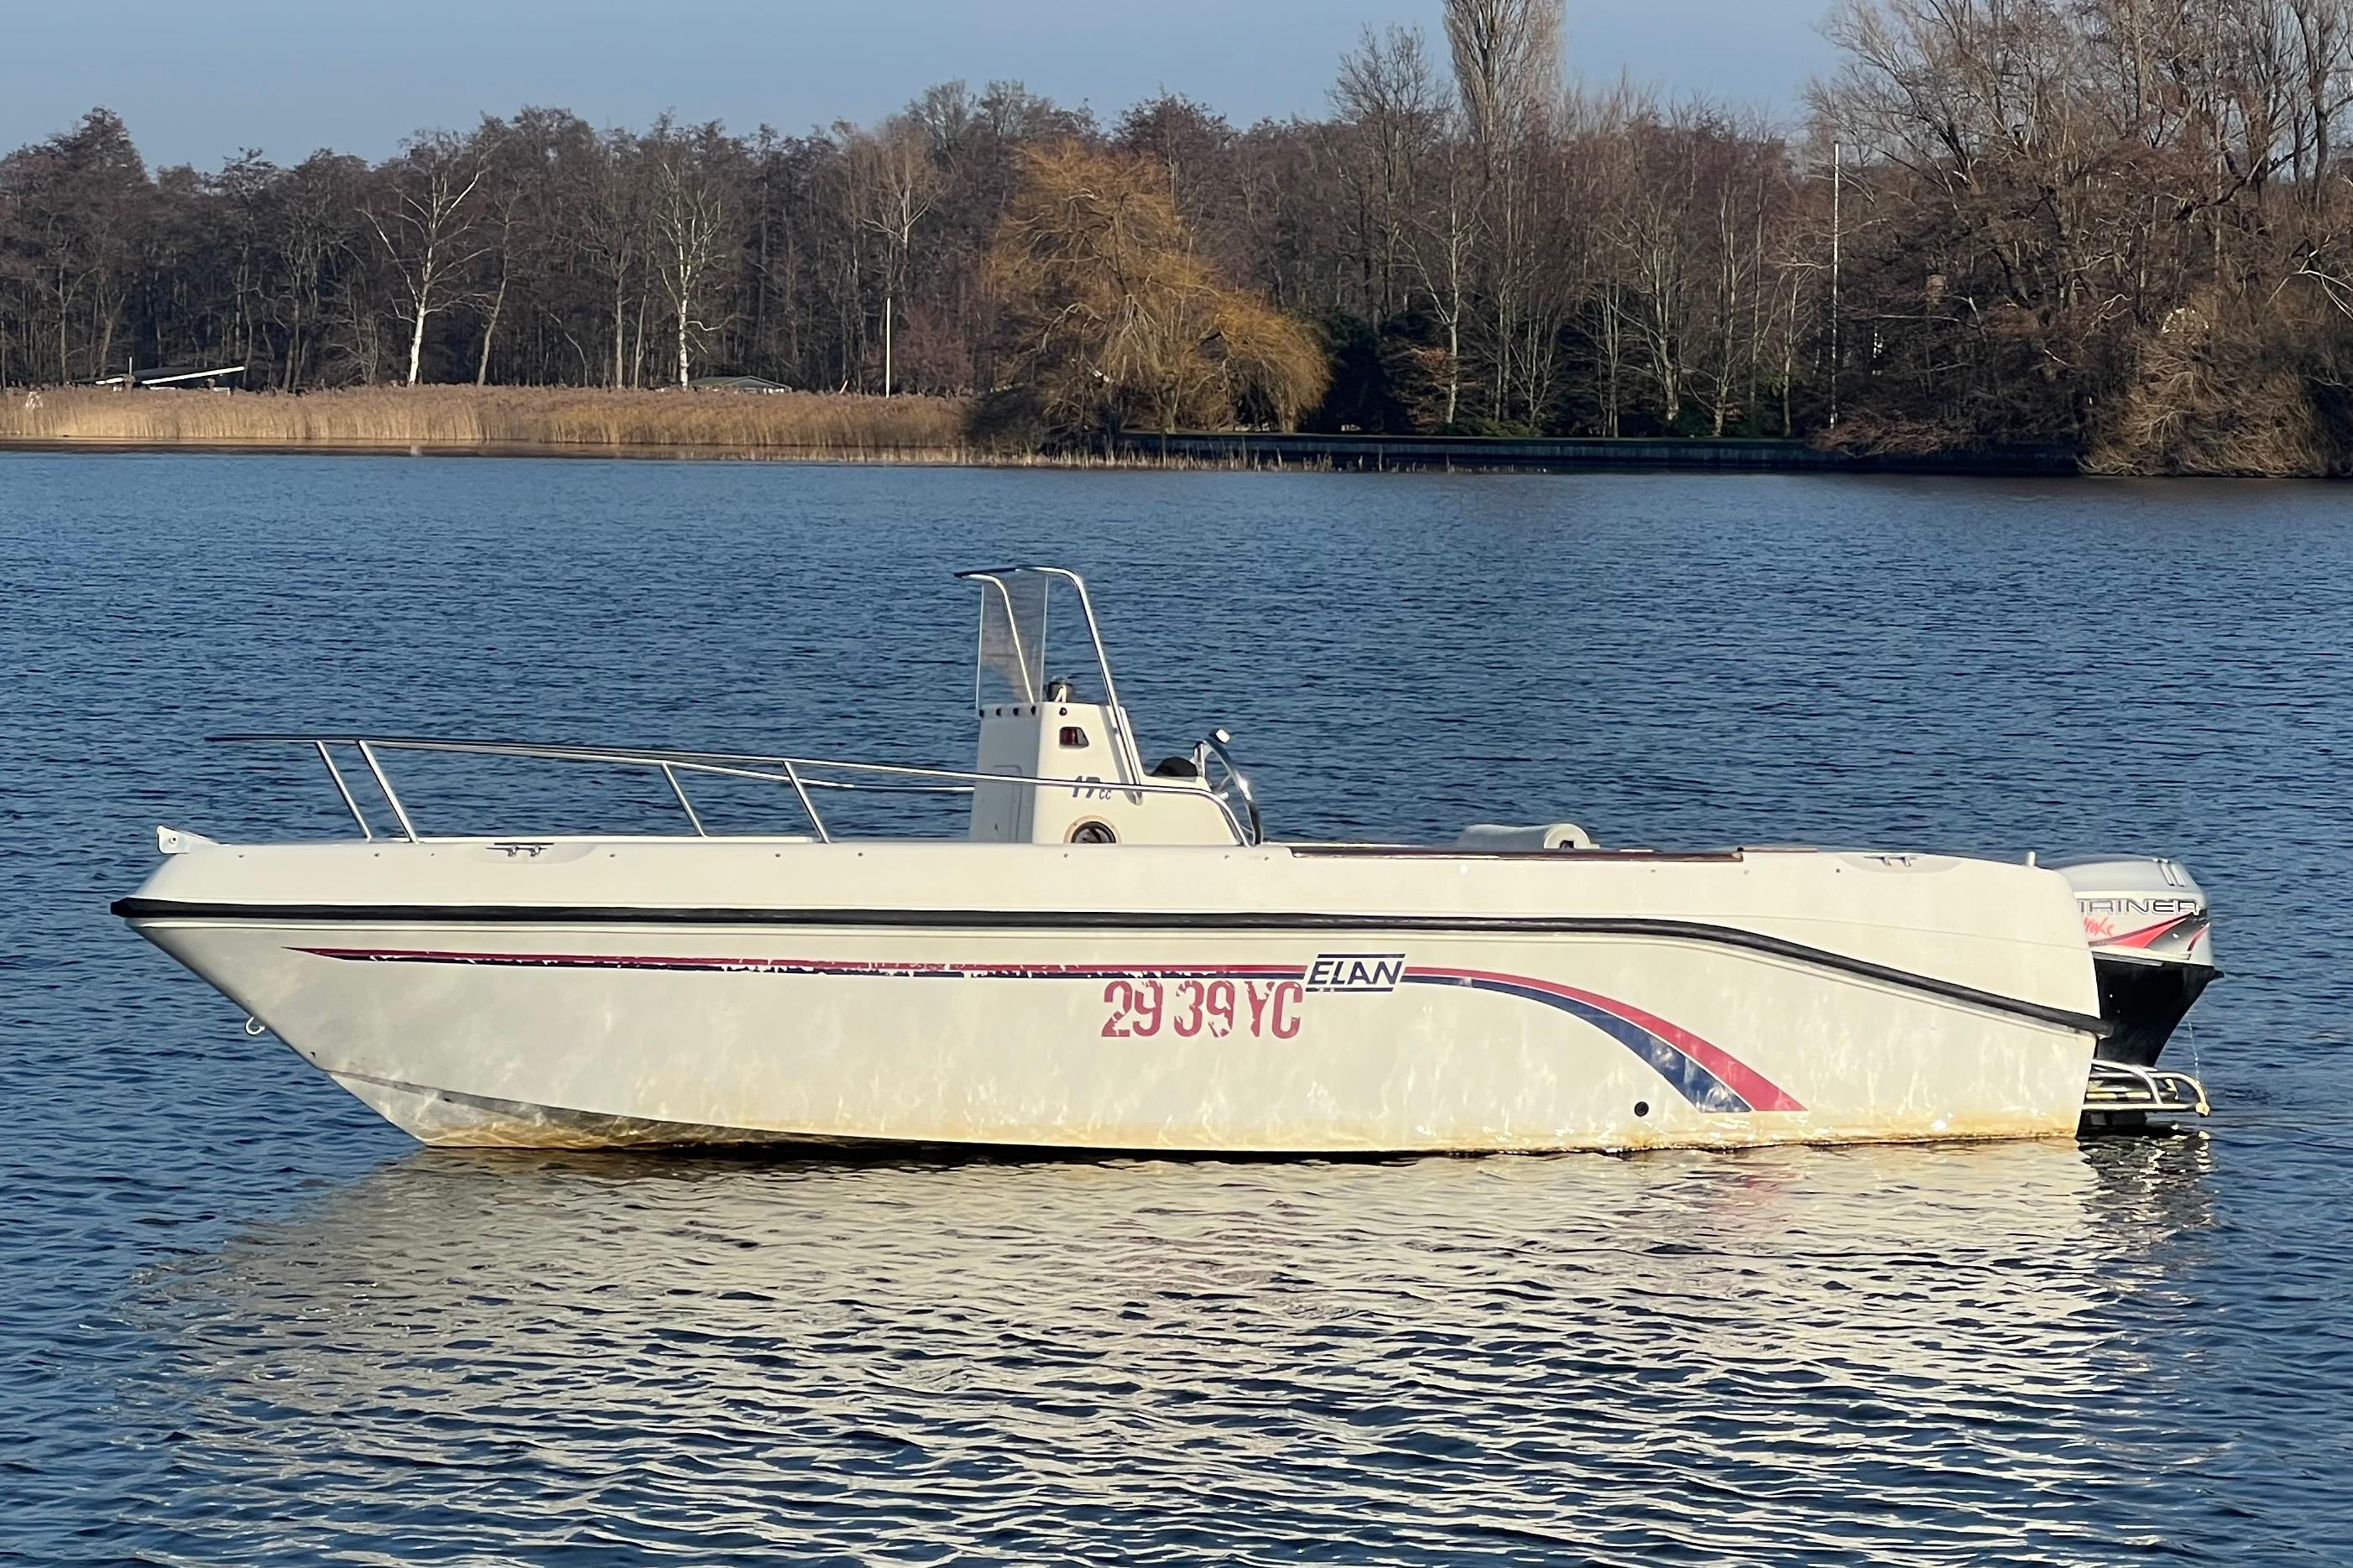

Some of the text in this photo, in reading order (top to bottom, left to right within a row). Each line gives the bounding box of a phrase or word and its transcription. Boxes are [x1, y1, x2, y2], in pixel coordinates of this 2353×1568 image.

[1307, 960, 1404, 986] ELAN
[1101, 980, 1304, 1039] 29 39 YC
